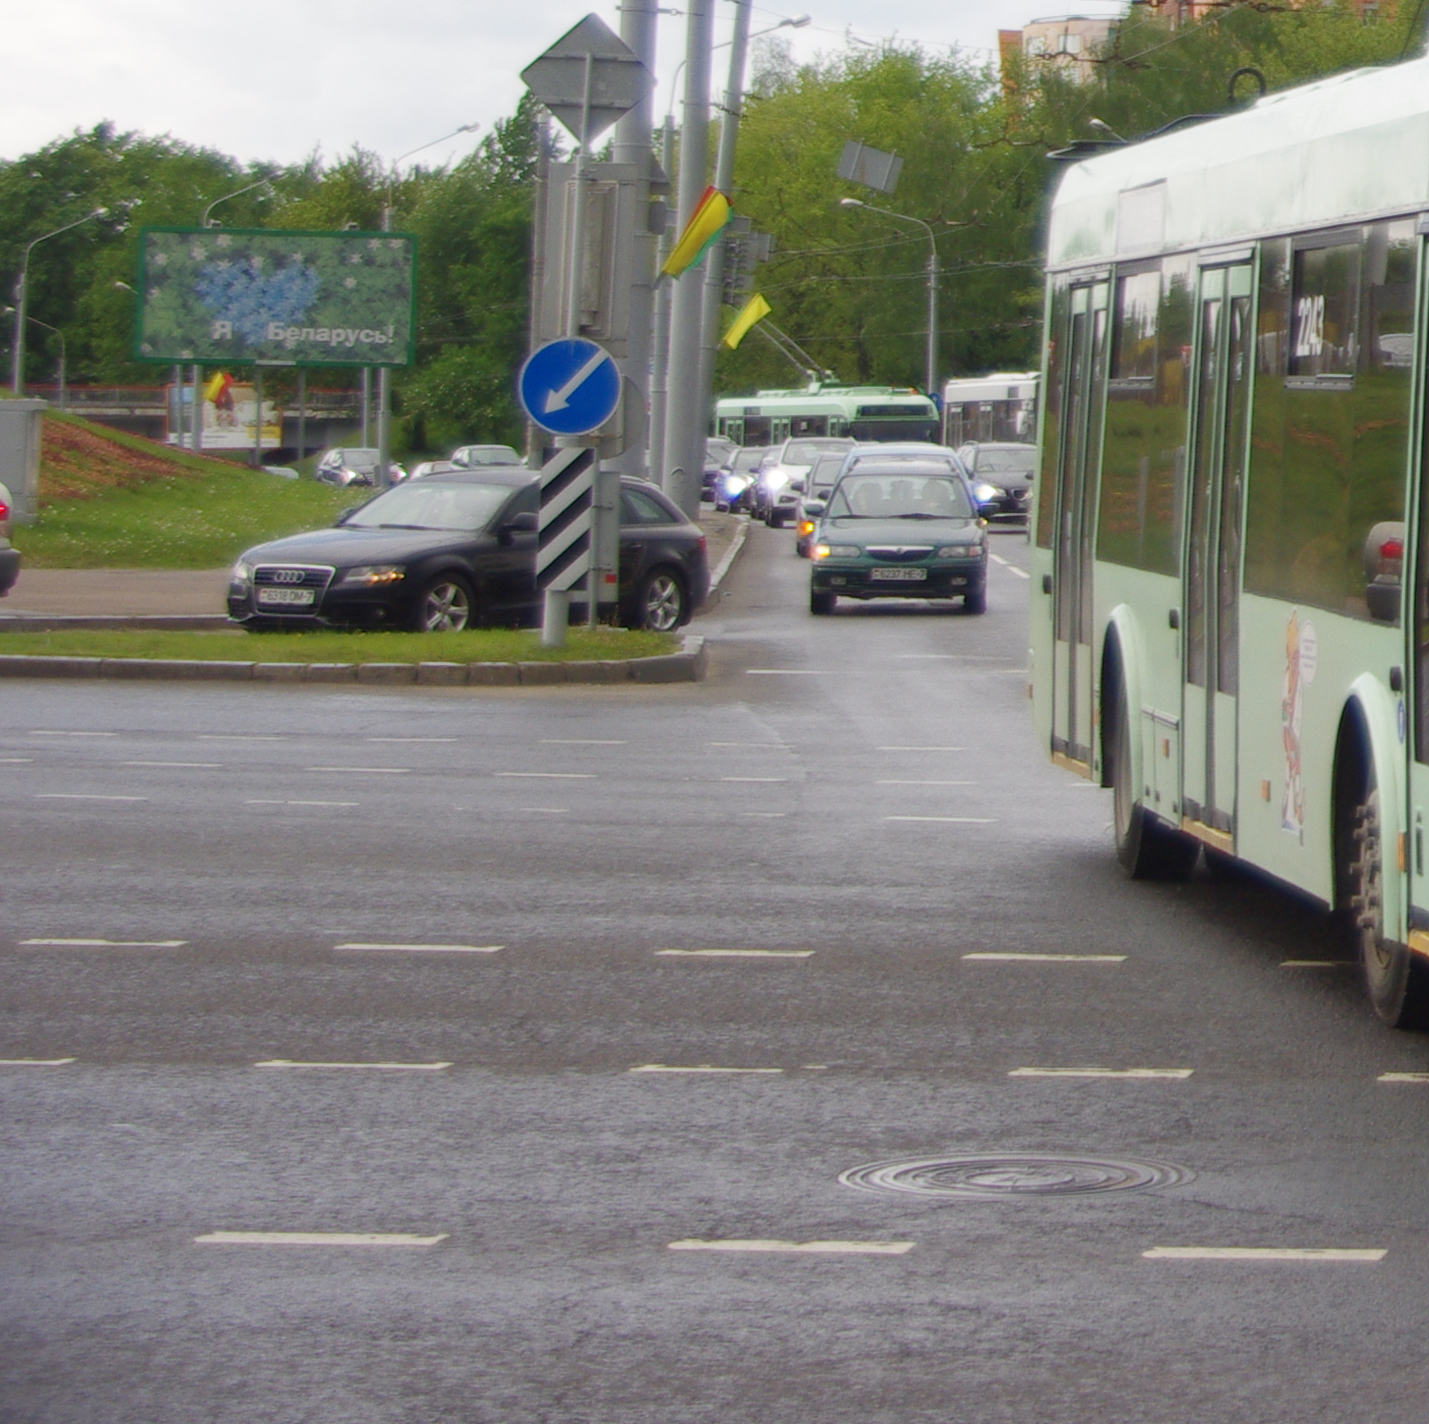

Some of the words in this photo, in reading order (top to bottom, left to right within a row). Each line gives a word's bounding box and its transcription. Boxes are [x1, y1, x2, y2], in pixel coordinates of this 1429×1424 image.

[211, 319, 233, 341] Я
[267, 321, 395, 348] Беларусь!
[1296, 294, 1325, 357] 2243
